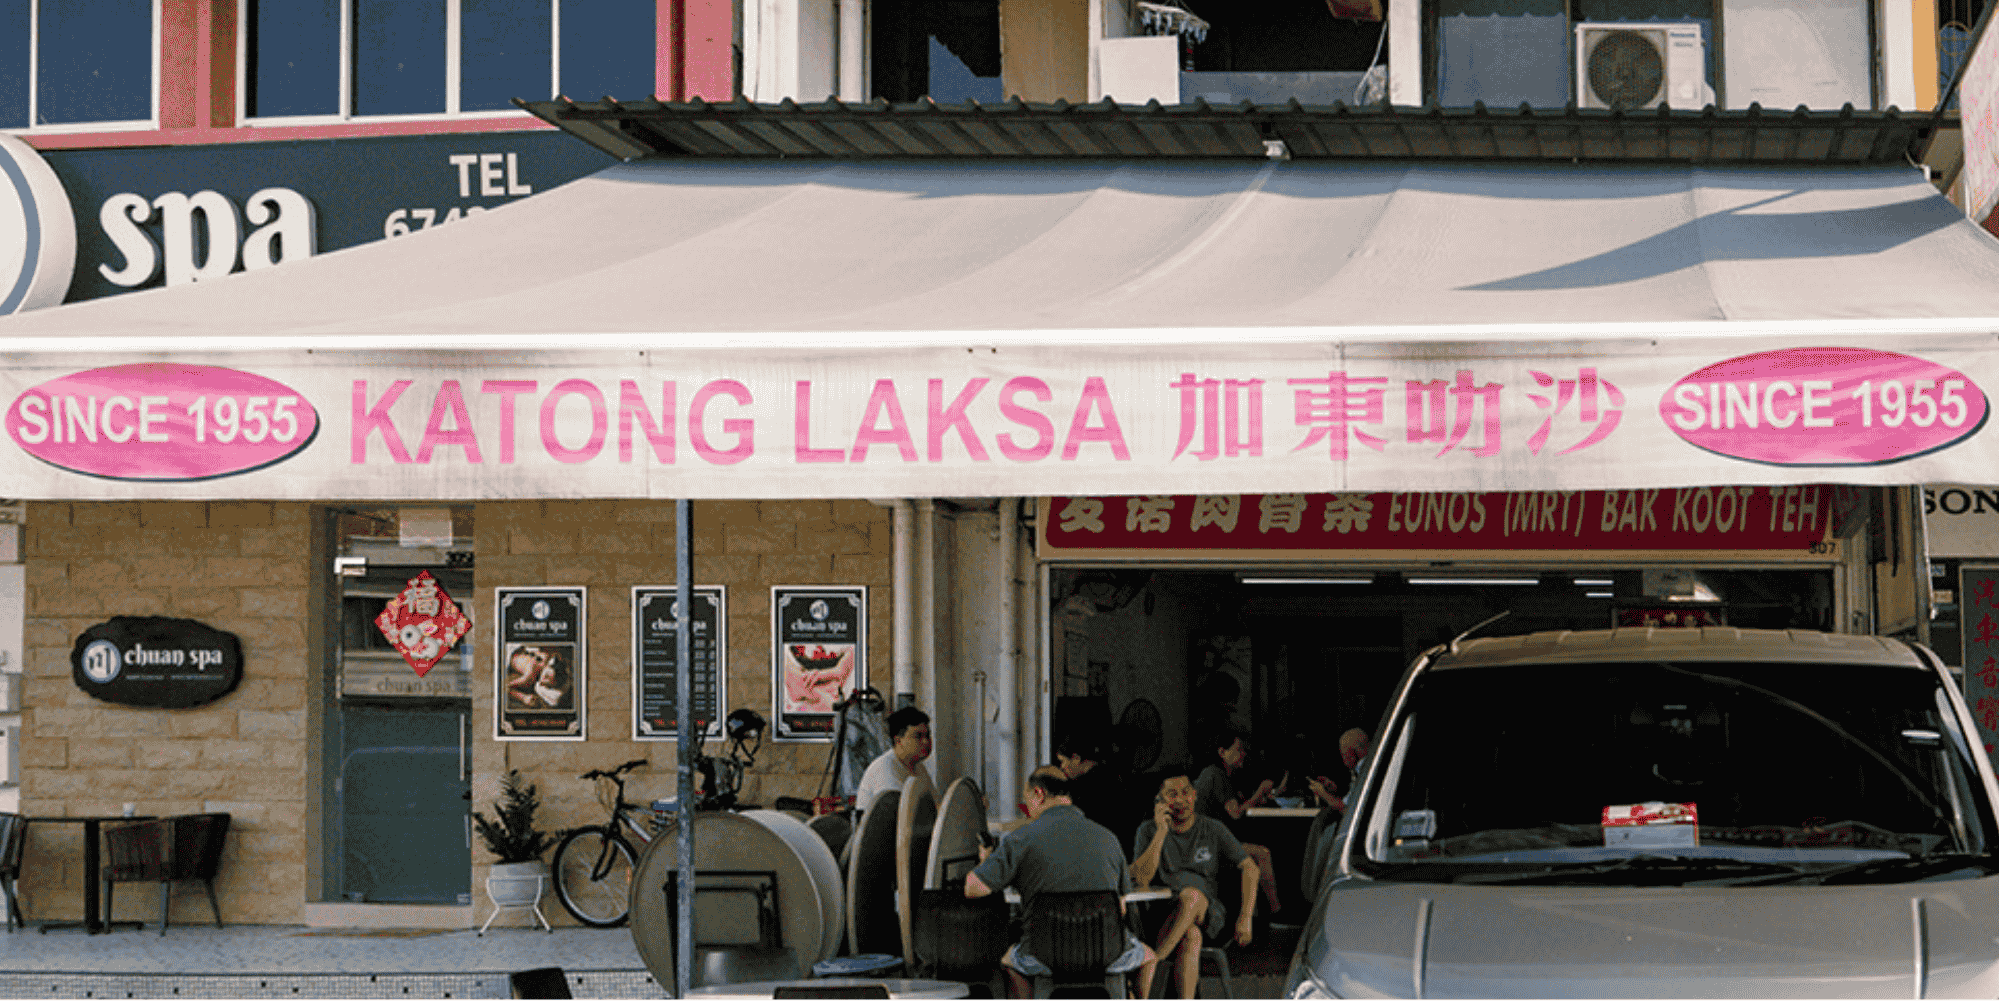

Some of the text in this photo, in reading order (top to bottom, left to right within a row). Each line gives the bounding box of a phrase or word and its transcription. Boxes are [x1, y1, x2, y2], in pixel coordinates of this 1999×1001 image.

[450, 153, 532, 197] TEL
[98, 187, 314, 287] spa
[18, 394, 299, 444] SINCE 1955
[350, 375, 1132, 465] KATONG LAKSA
[1169, 367, 1627, 463] 加東叻沙
[1672, 379, 1968, 431] SINCE 1955
[1387, 485, 1820, 537] EUNOS (MRT) BAK KOOT TEH
[403, 577, 441, 617] 福
[124, 643, 185, 667] chuan
[189, 649, 223, 671] spa
